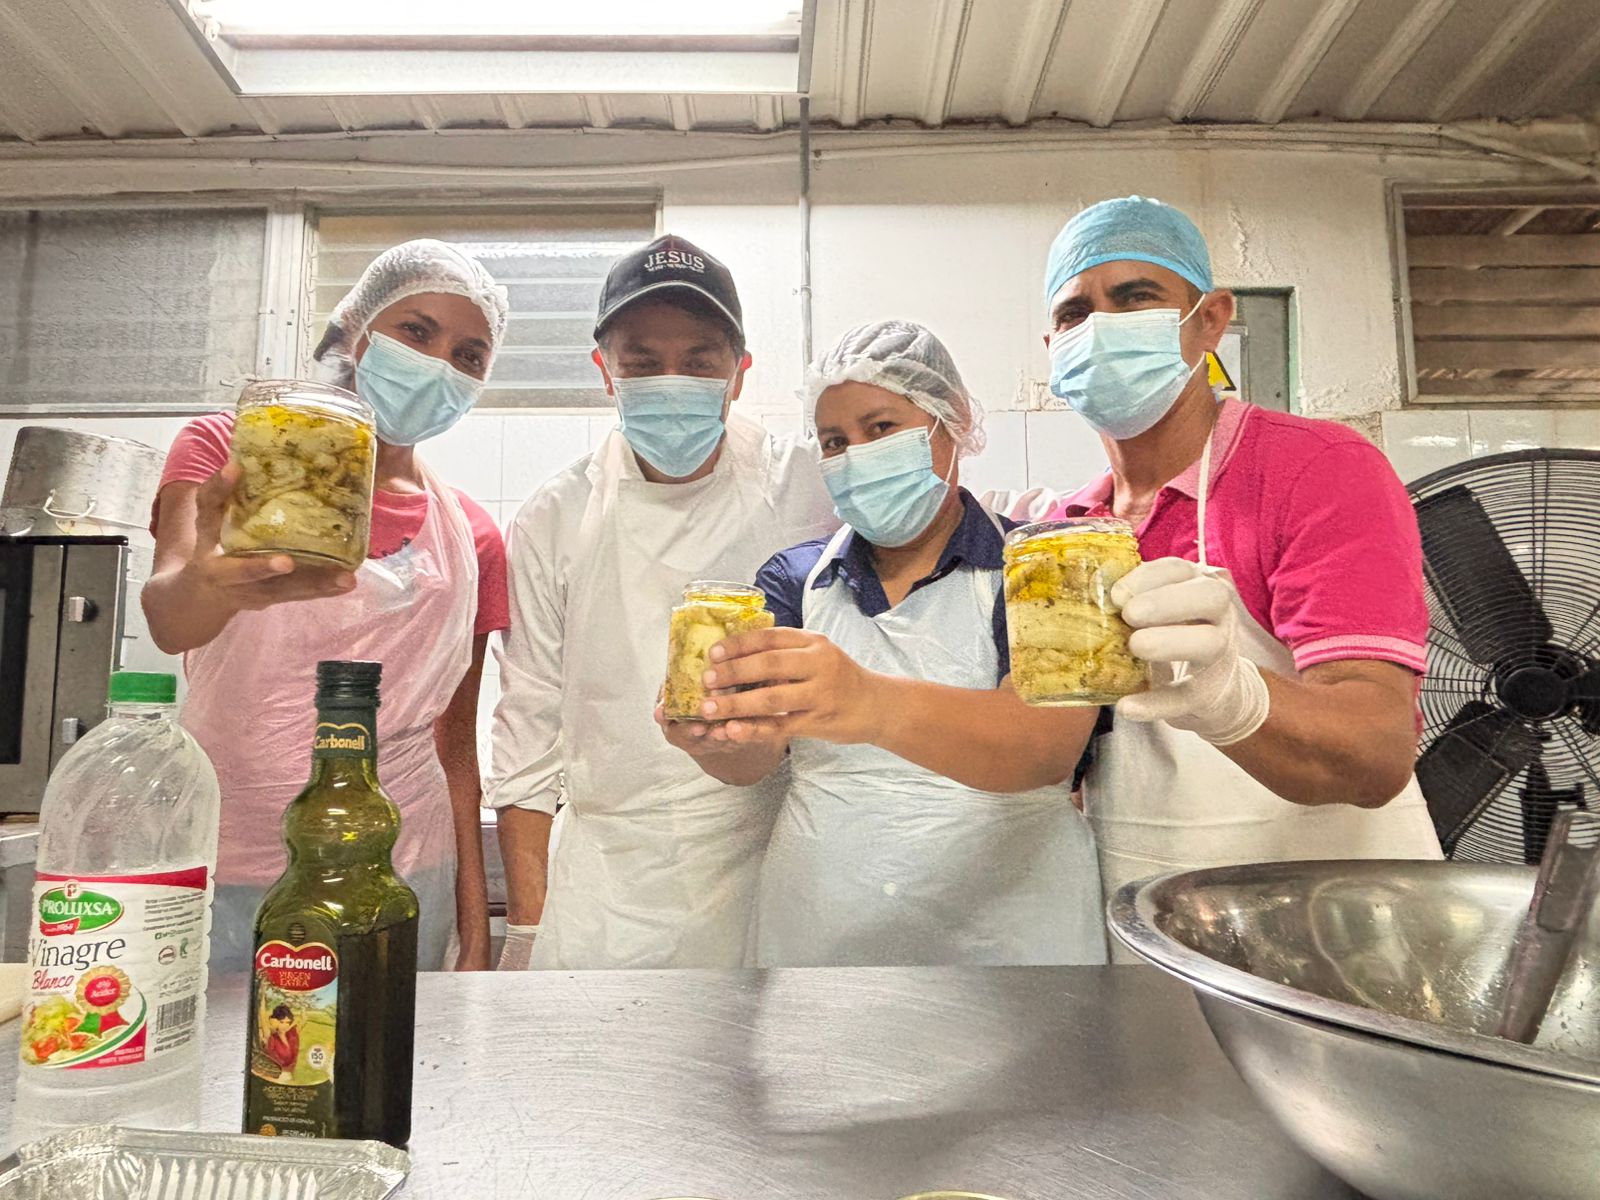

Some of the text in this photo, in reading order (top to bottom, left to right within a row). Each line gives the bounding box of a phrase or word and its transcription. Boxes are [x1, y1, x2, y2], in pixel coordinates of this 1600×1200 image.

[644, 250, 705, 269] JESUS
[314, 733, 365, 750] Carbonell
[42, 899, 113, 916] PROLUXSA
[260, 952, 333, 971] Carbonell
[32, 968, 75, 990] Blanco
